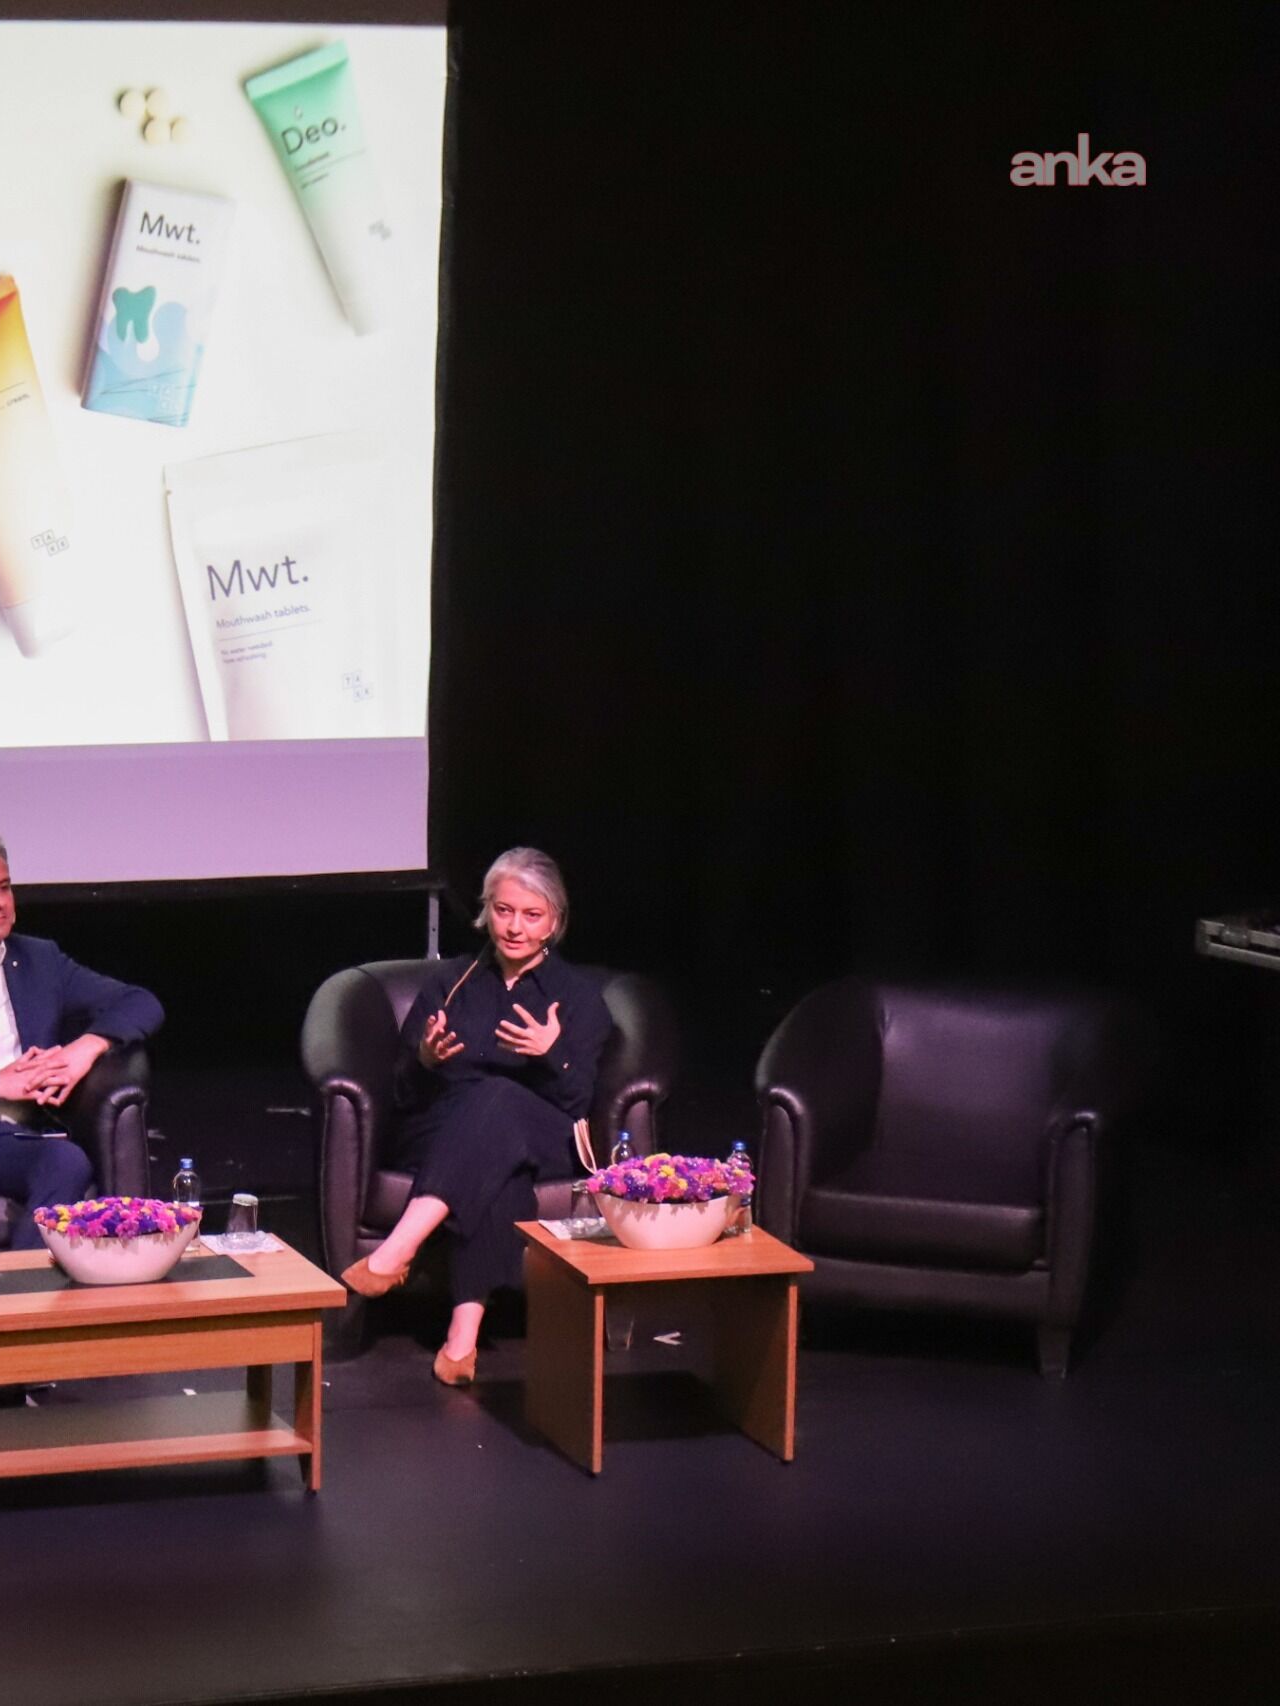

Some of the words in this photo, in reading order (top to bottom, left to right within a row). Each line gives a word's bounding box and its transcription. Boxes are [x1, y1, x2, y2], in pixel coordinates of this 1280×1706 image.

[281, 117, 346, 155] Deo.
[140, 212, 200, 245] Mwt.
[207, 555, 308, 600] Mwt.
